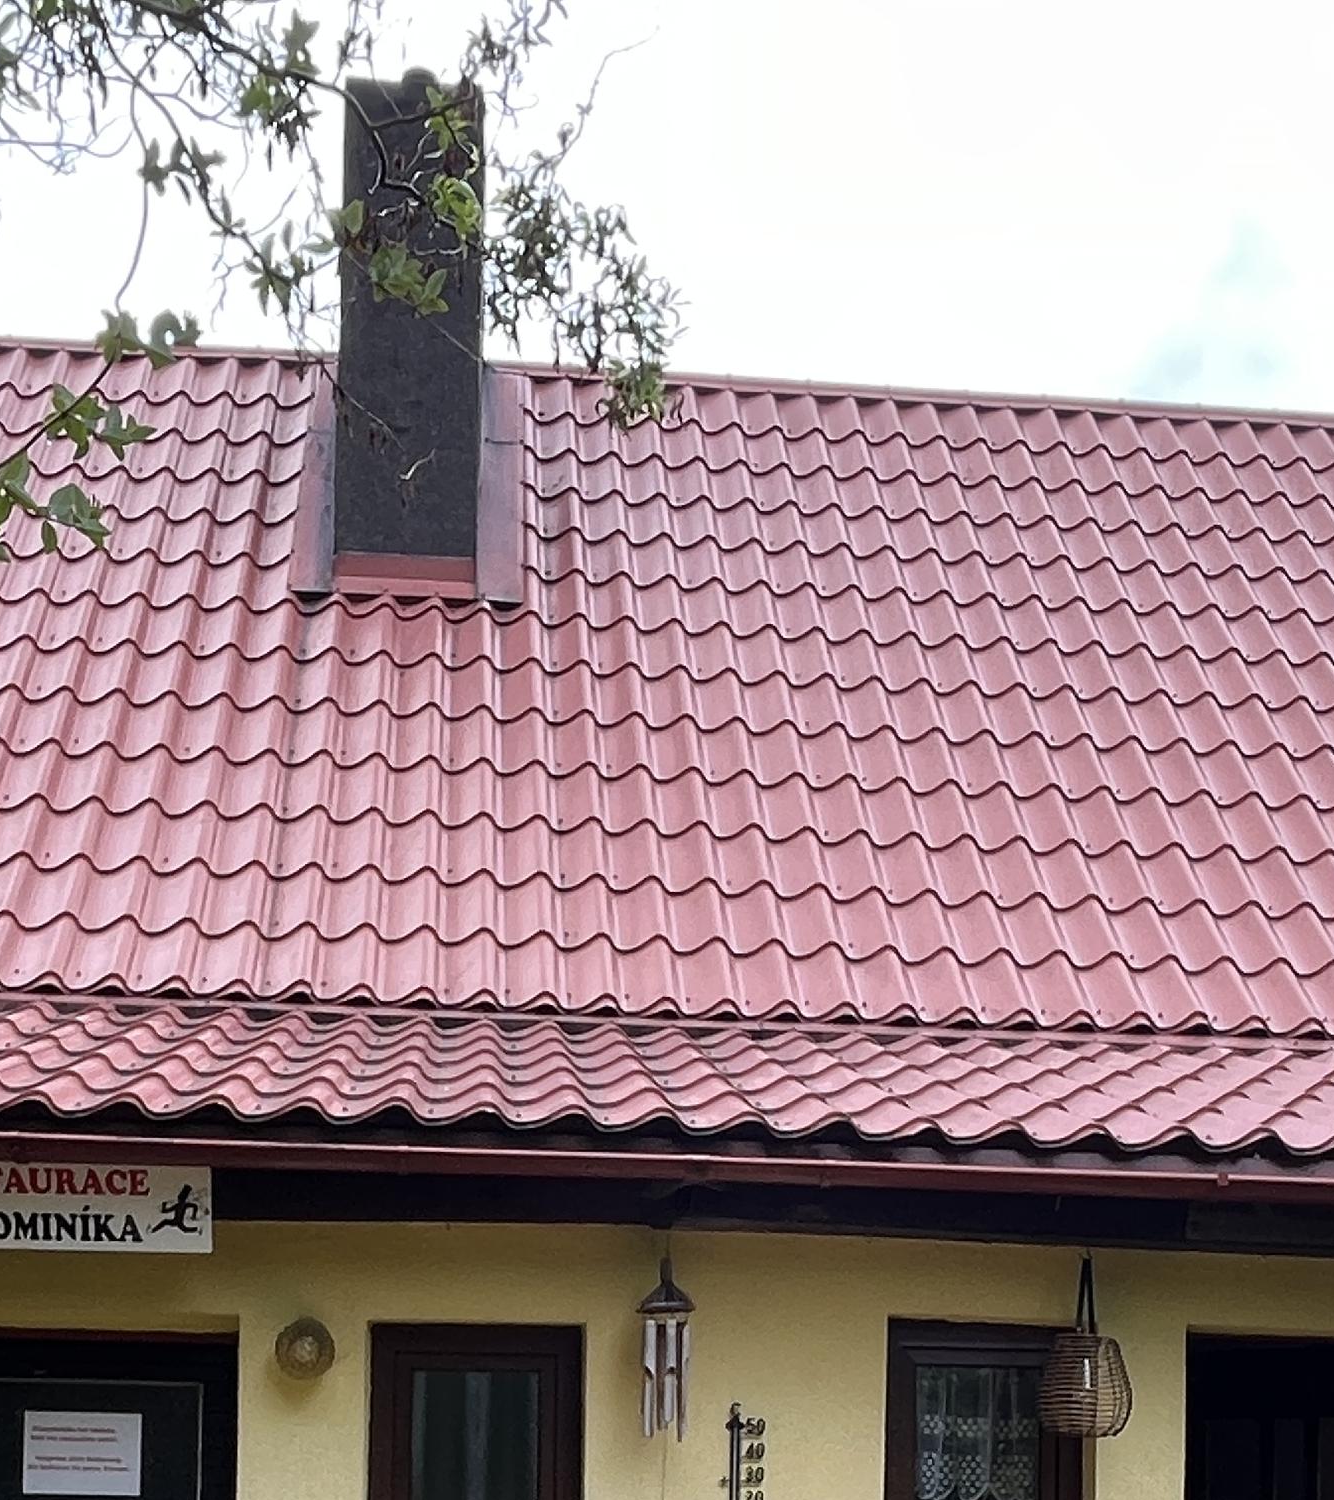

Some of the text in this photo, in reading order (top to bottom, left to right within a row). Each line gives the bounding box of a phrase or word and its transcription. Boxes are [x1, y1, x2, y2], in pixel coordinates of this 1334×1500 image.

[745, 1417, 766, 1436] 50
[745, 1443, 765, 1460] 40
[745, 1466, 764, 1484] 30
